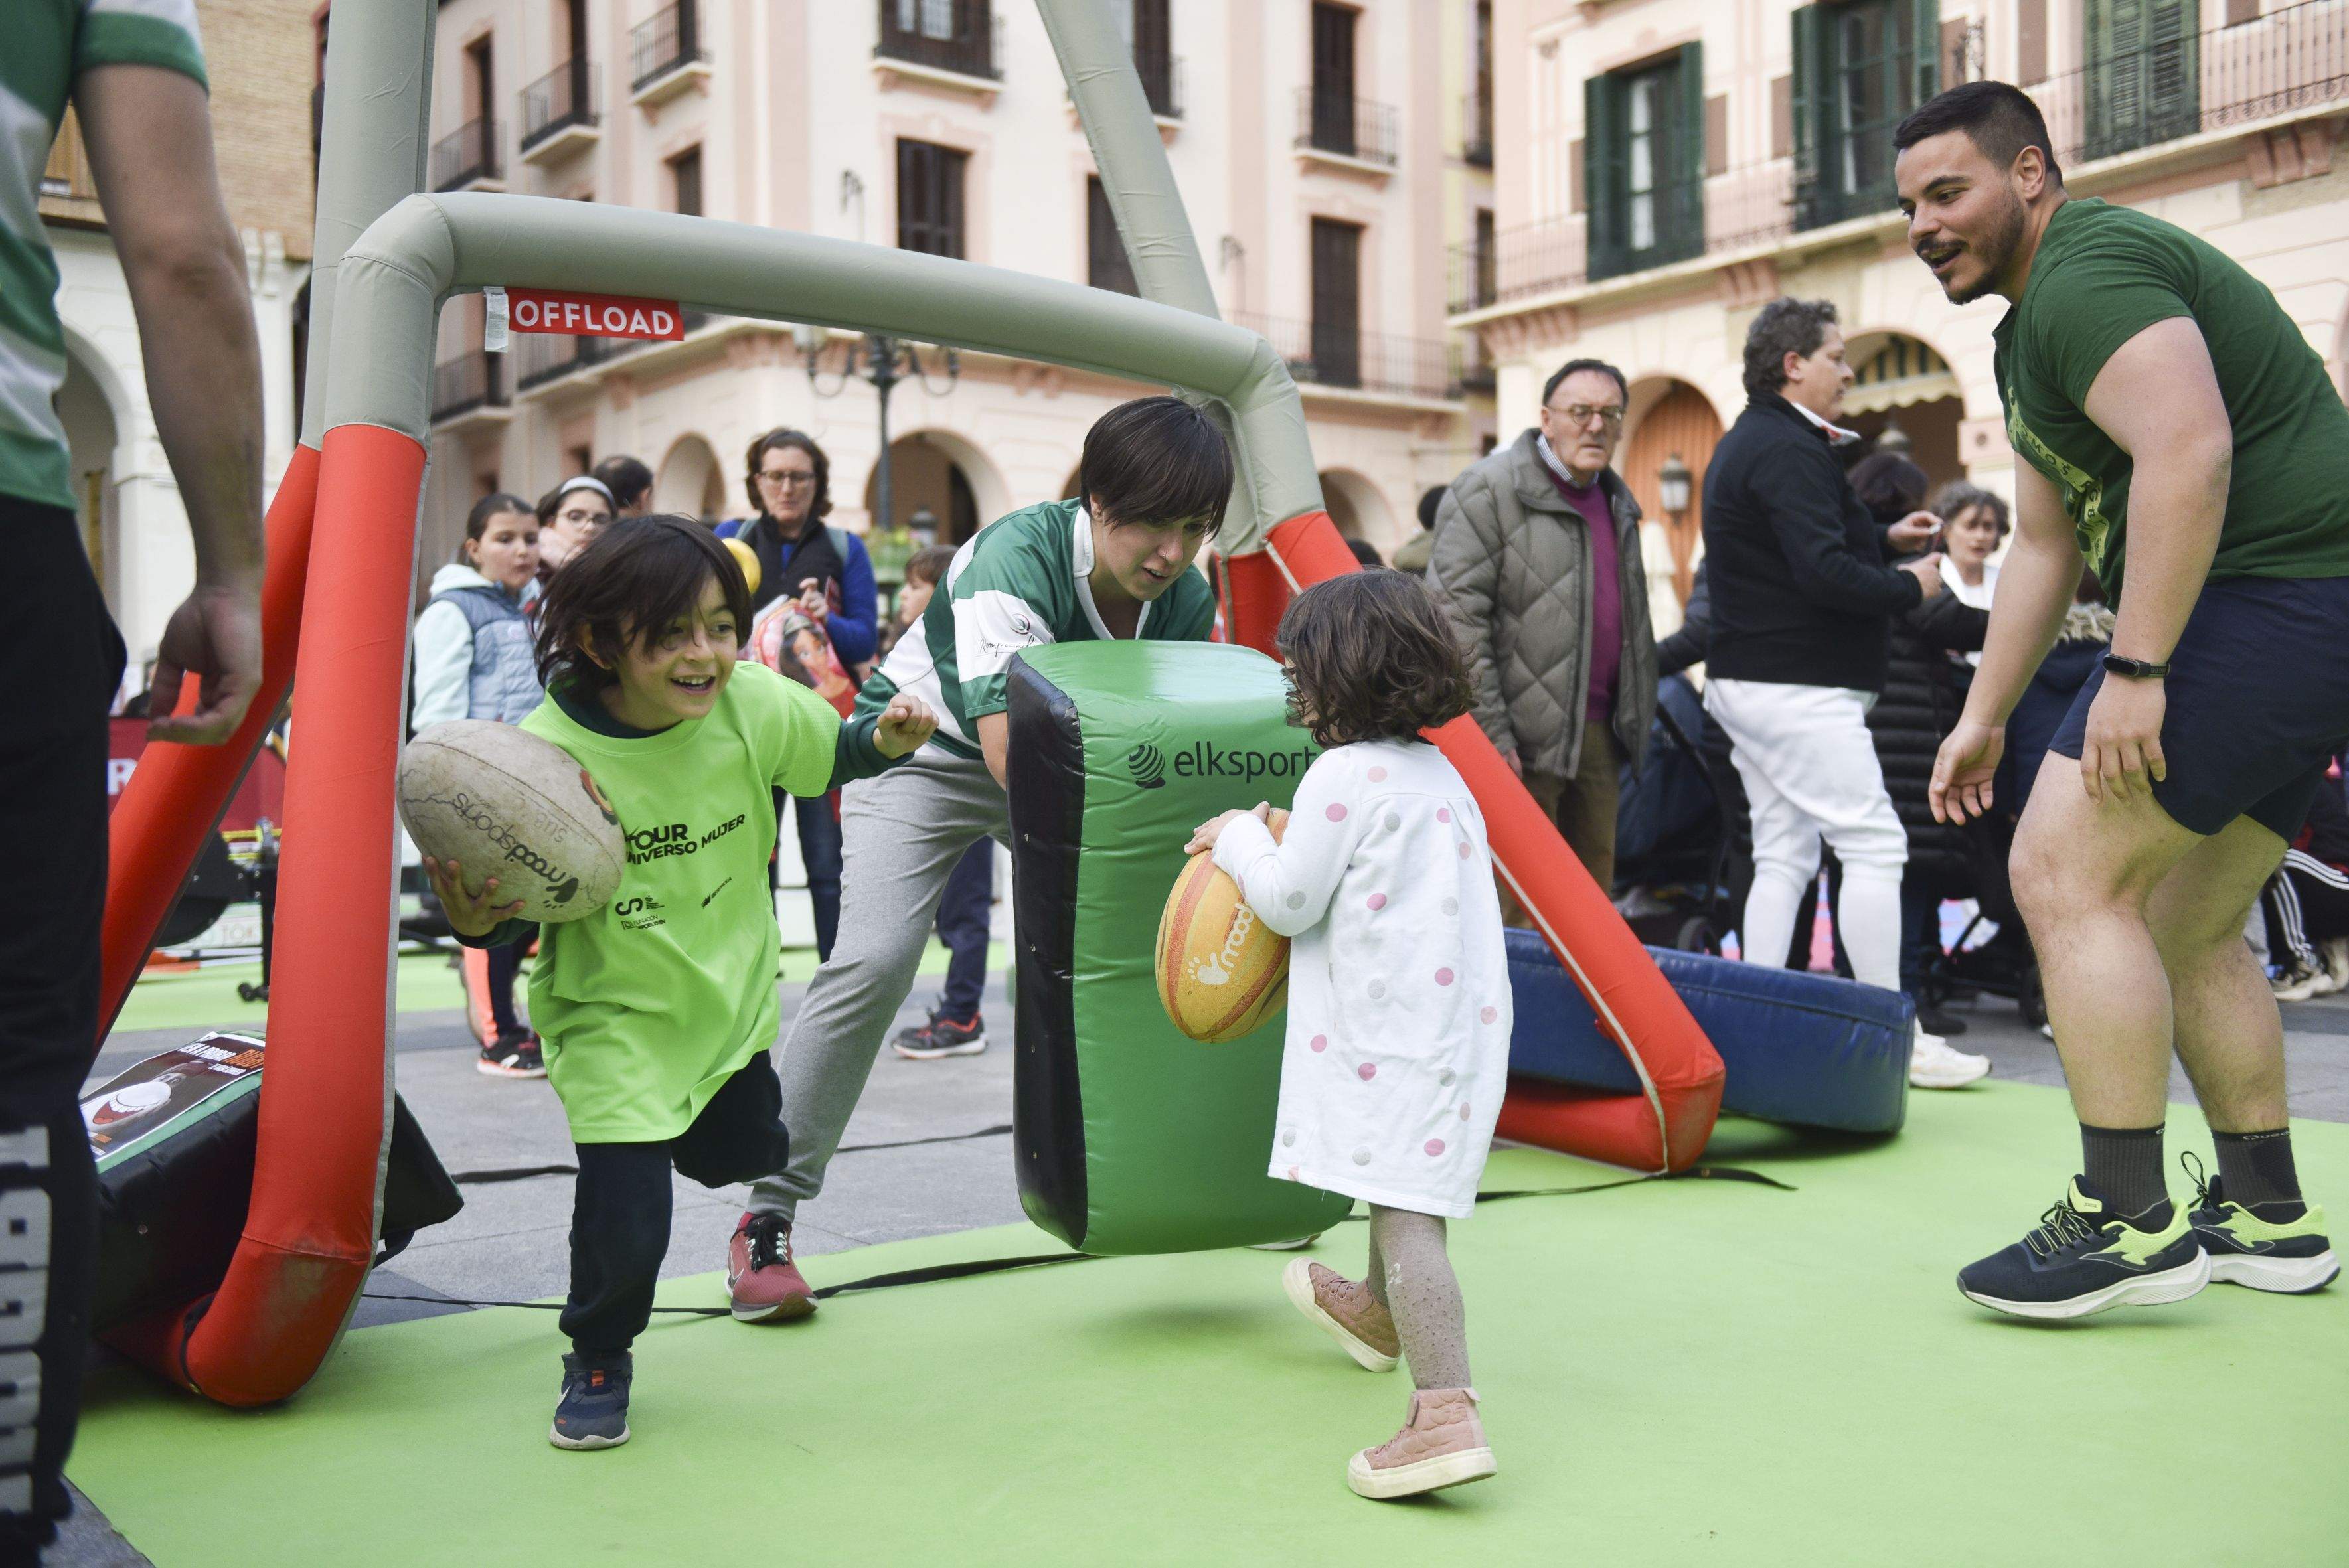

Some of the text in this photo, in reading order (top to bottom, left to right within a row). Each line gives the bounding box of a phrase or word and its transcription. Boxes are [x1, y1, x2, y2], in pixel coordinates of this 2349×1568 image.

[515, 300, 674, 335] OFFLOAD
[1174, 741, 1317, 783] elksport
[627, 814, 745, 865] NIVERSO MUJER
